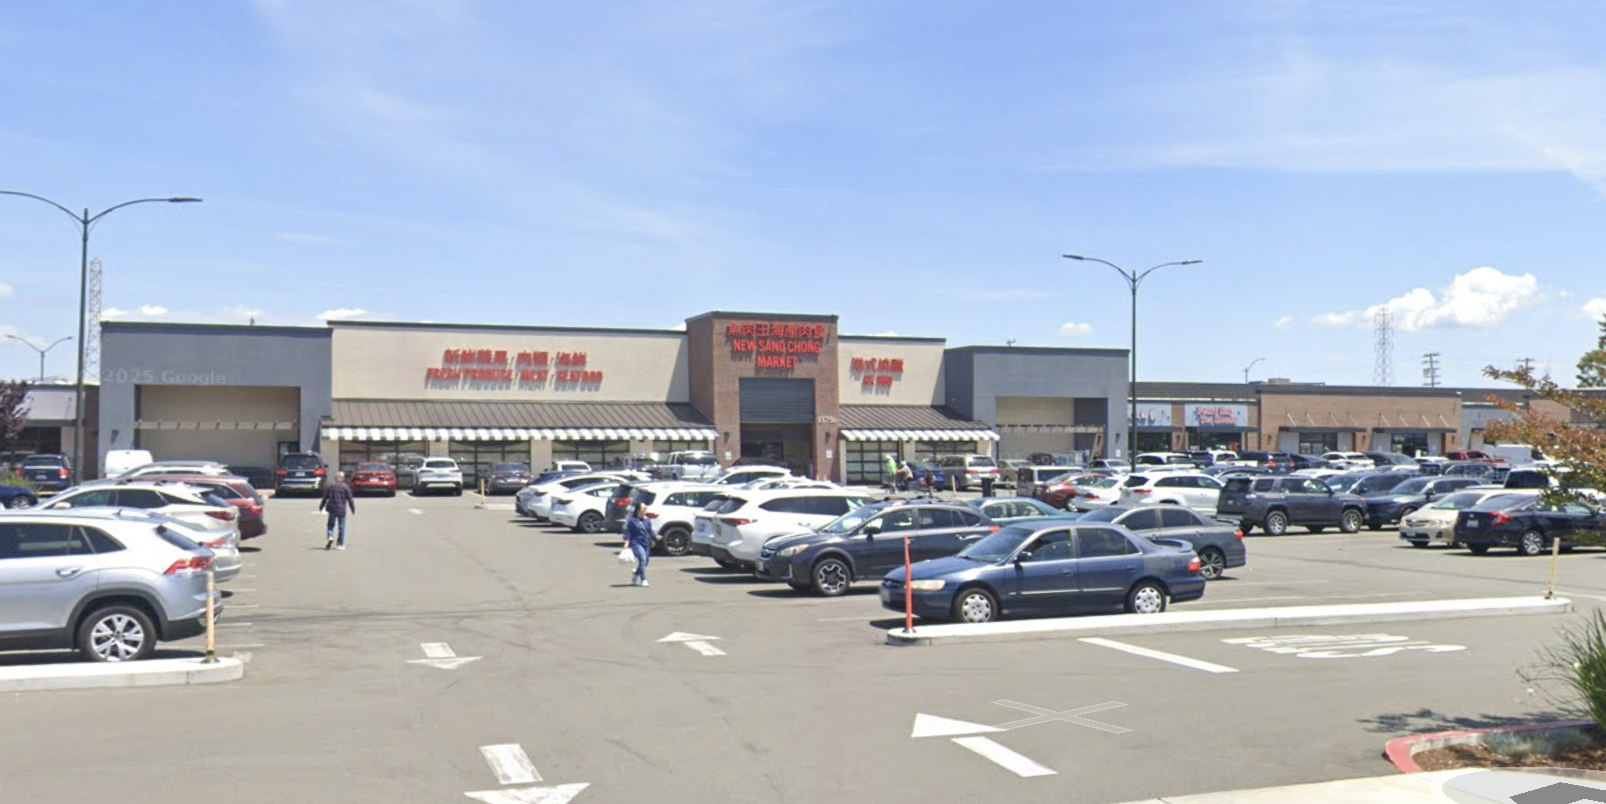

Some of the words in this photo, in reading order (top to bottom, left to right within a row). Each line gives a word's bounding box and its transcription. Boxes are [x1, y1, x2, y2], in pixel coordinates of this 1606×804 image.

[733, 339, 757, 352] NEW
[758, 340, 786, 353] SANG
[787, 341, 822, 353] CHONG
[757, 356, 797, 368] MARKET
[426, 367, 461, 381] FRESH
[555, 370, 603, 383] SEAFOOD
